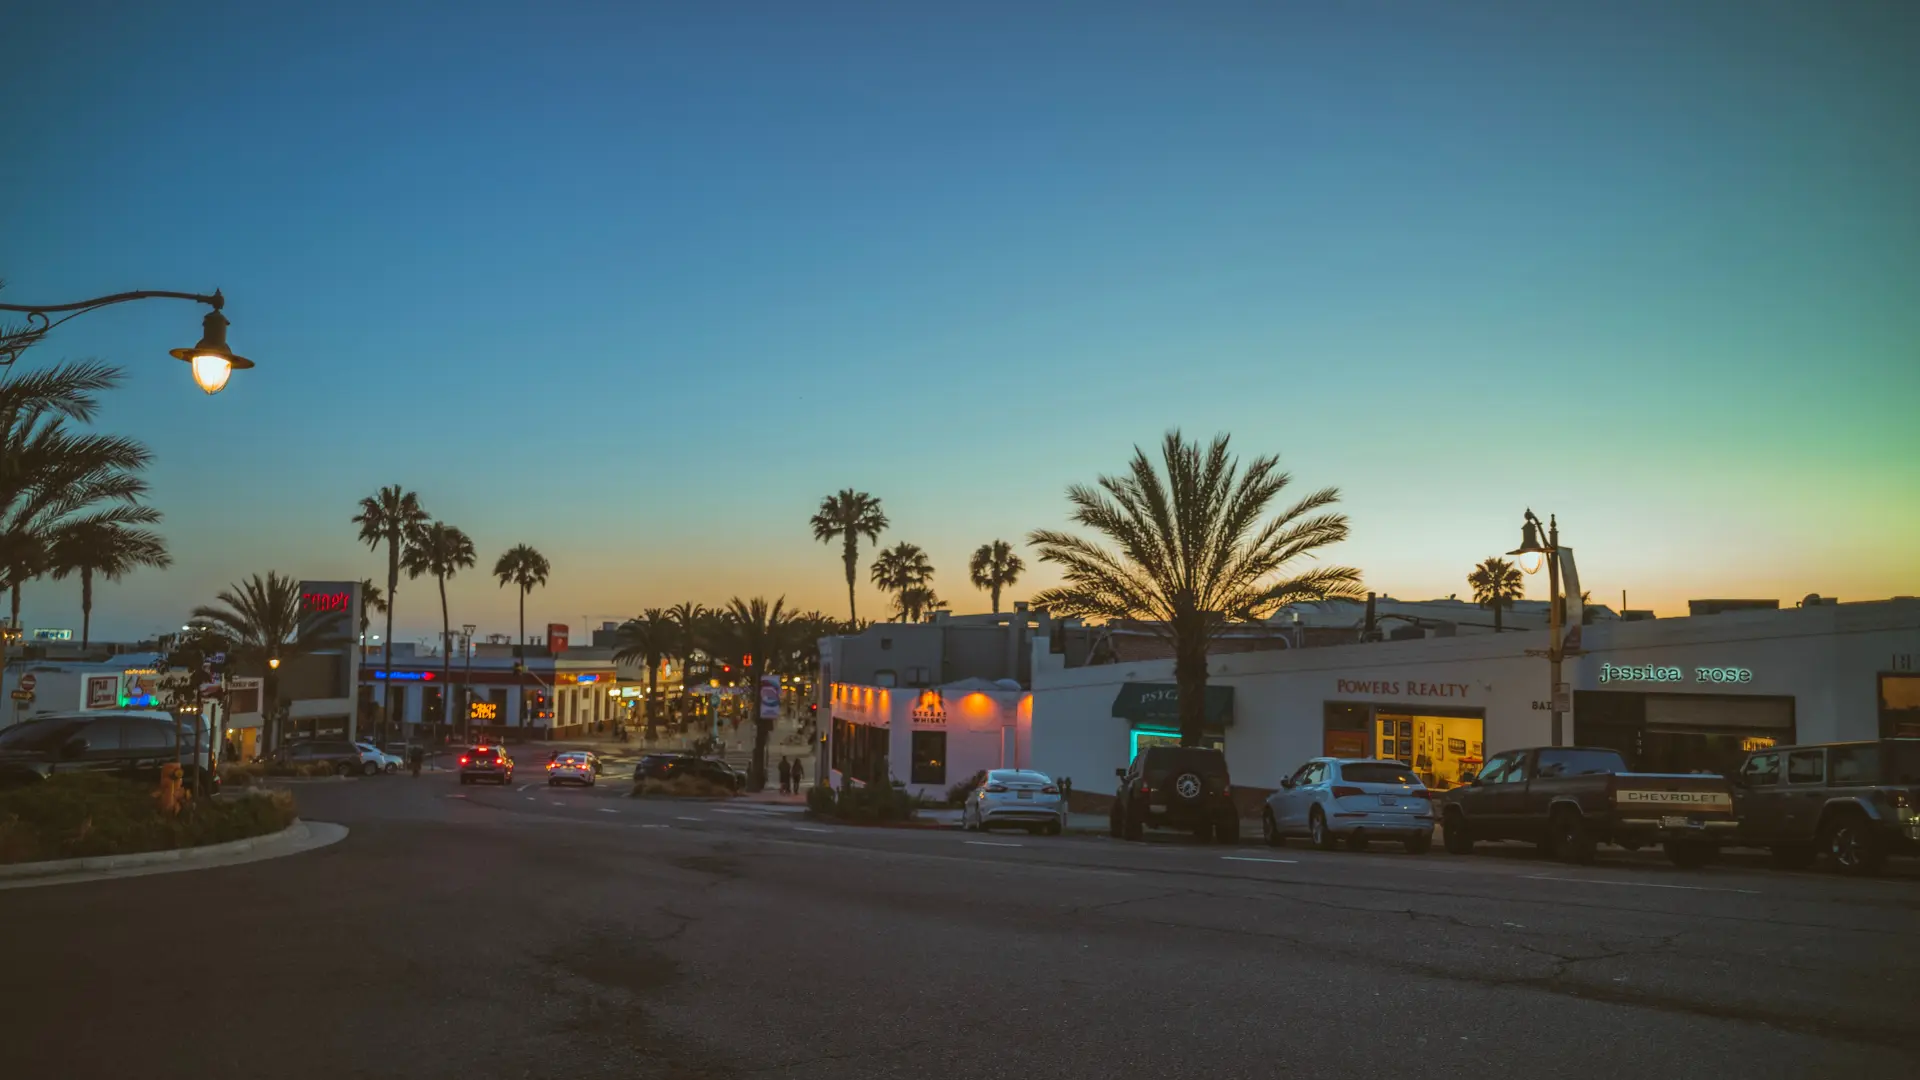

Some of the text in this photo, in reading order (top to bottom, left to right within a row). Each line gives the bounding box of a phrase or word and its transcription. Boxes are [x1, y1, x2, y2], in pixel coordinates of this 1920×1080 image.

[1600, 664, 1752, 683] jessica rose
[1337, 679, 1470, 698] POWERS REALTY
[1628, 792, 1719, 803] CHEVROLET
